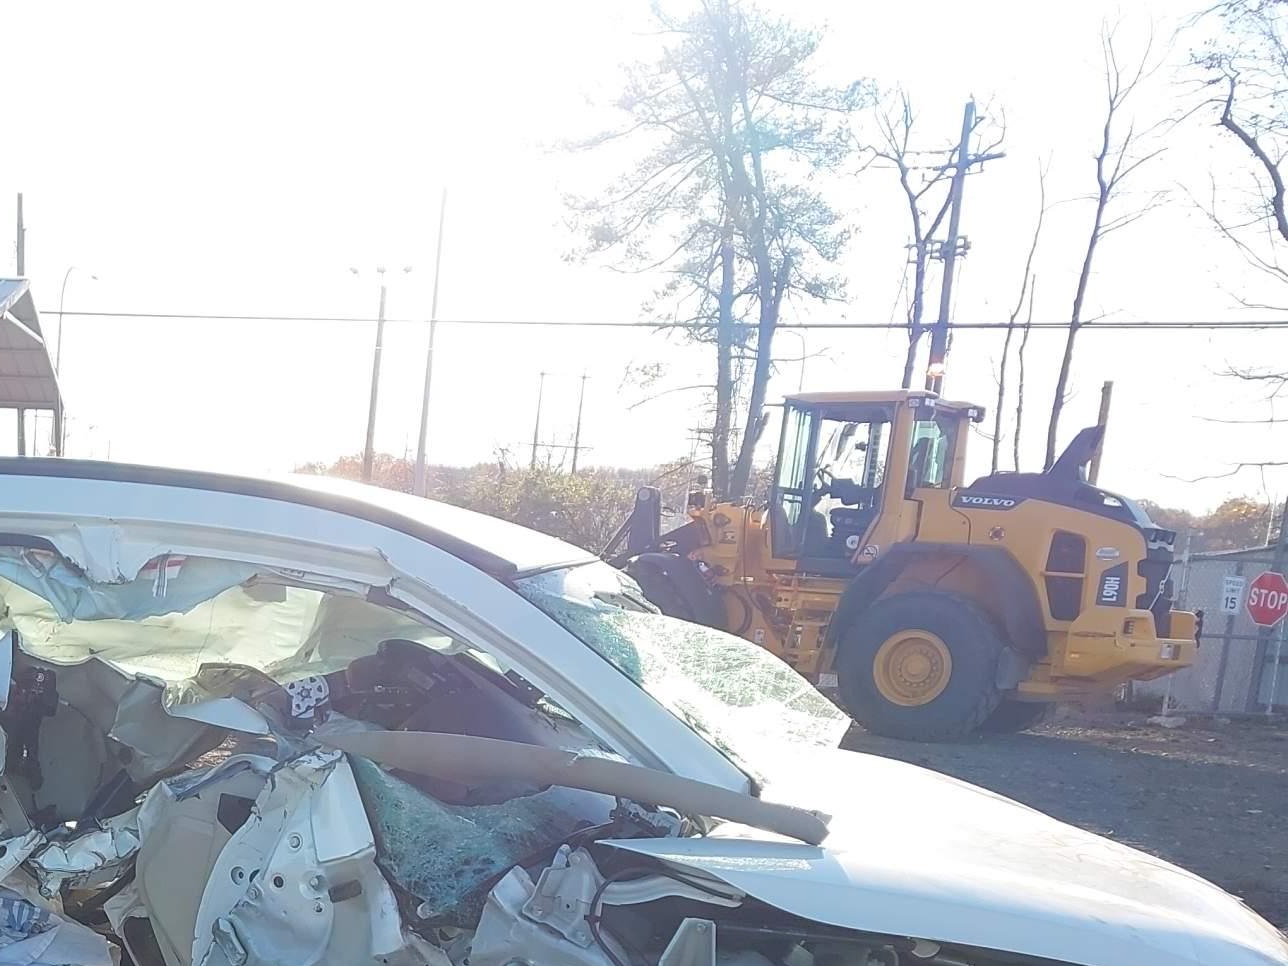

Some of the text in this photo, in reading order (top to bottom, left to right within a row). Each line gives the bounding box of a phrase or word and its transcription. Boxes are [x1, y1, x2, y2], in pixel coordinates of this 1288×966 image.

[961, 496, 1015, 507] VOLVO
[1102, 576, 1121, 601] L90H
[1224, 596, 1237, 609] 15
[1249, 587, 1288, 610] STOP
